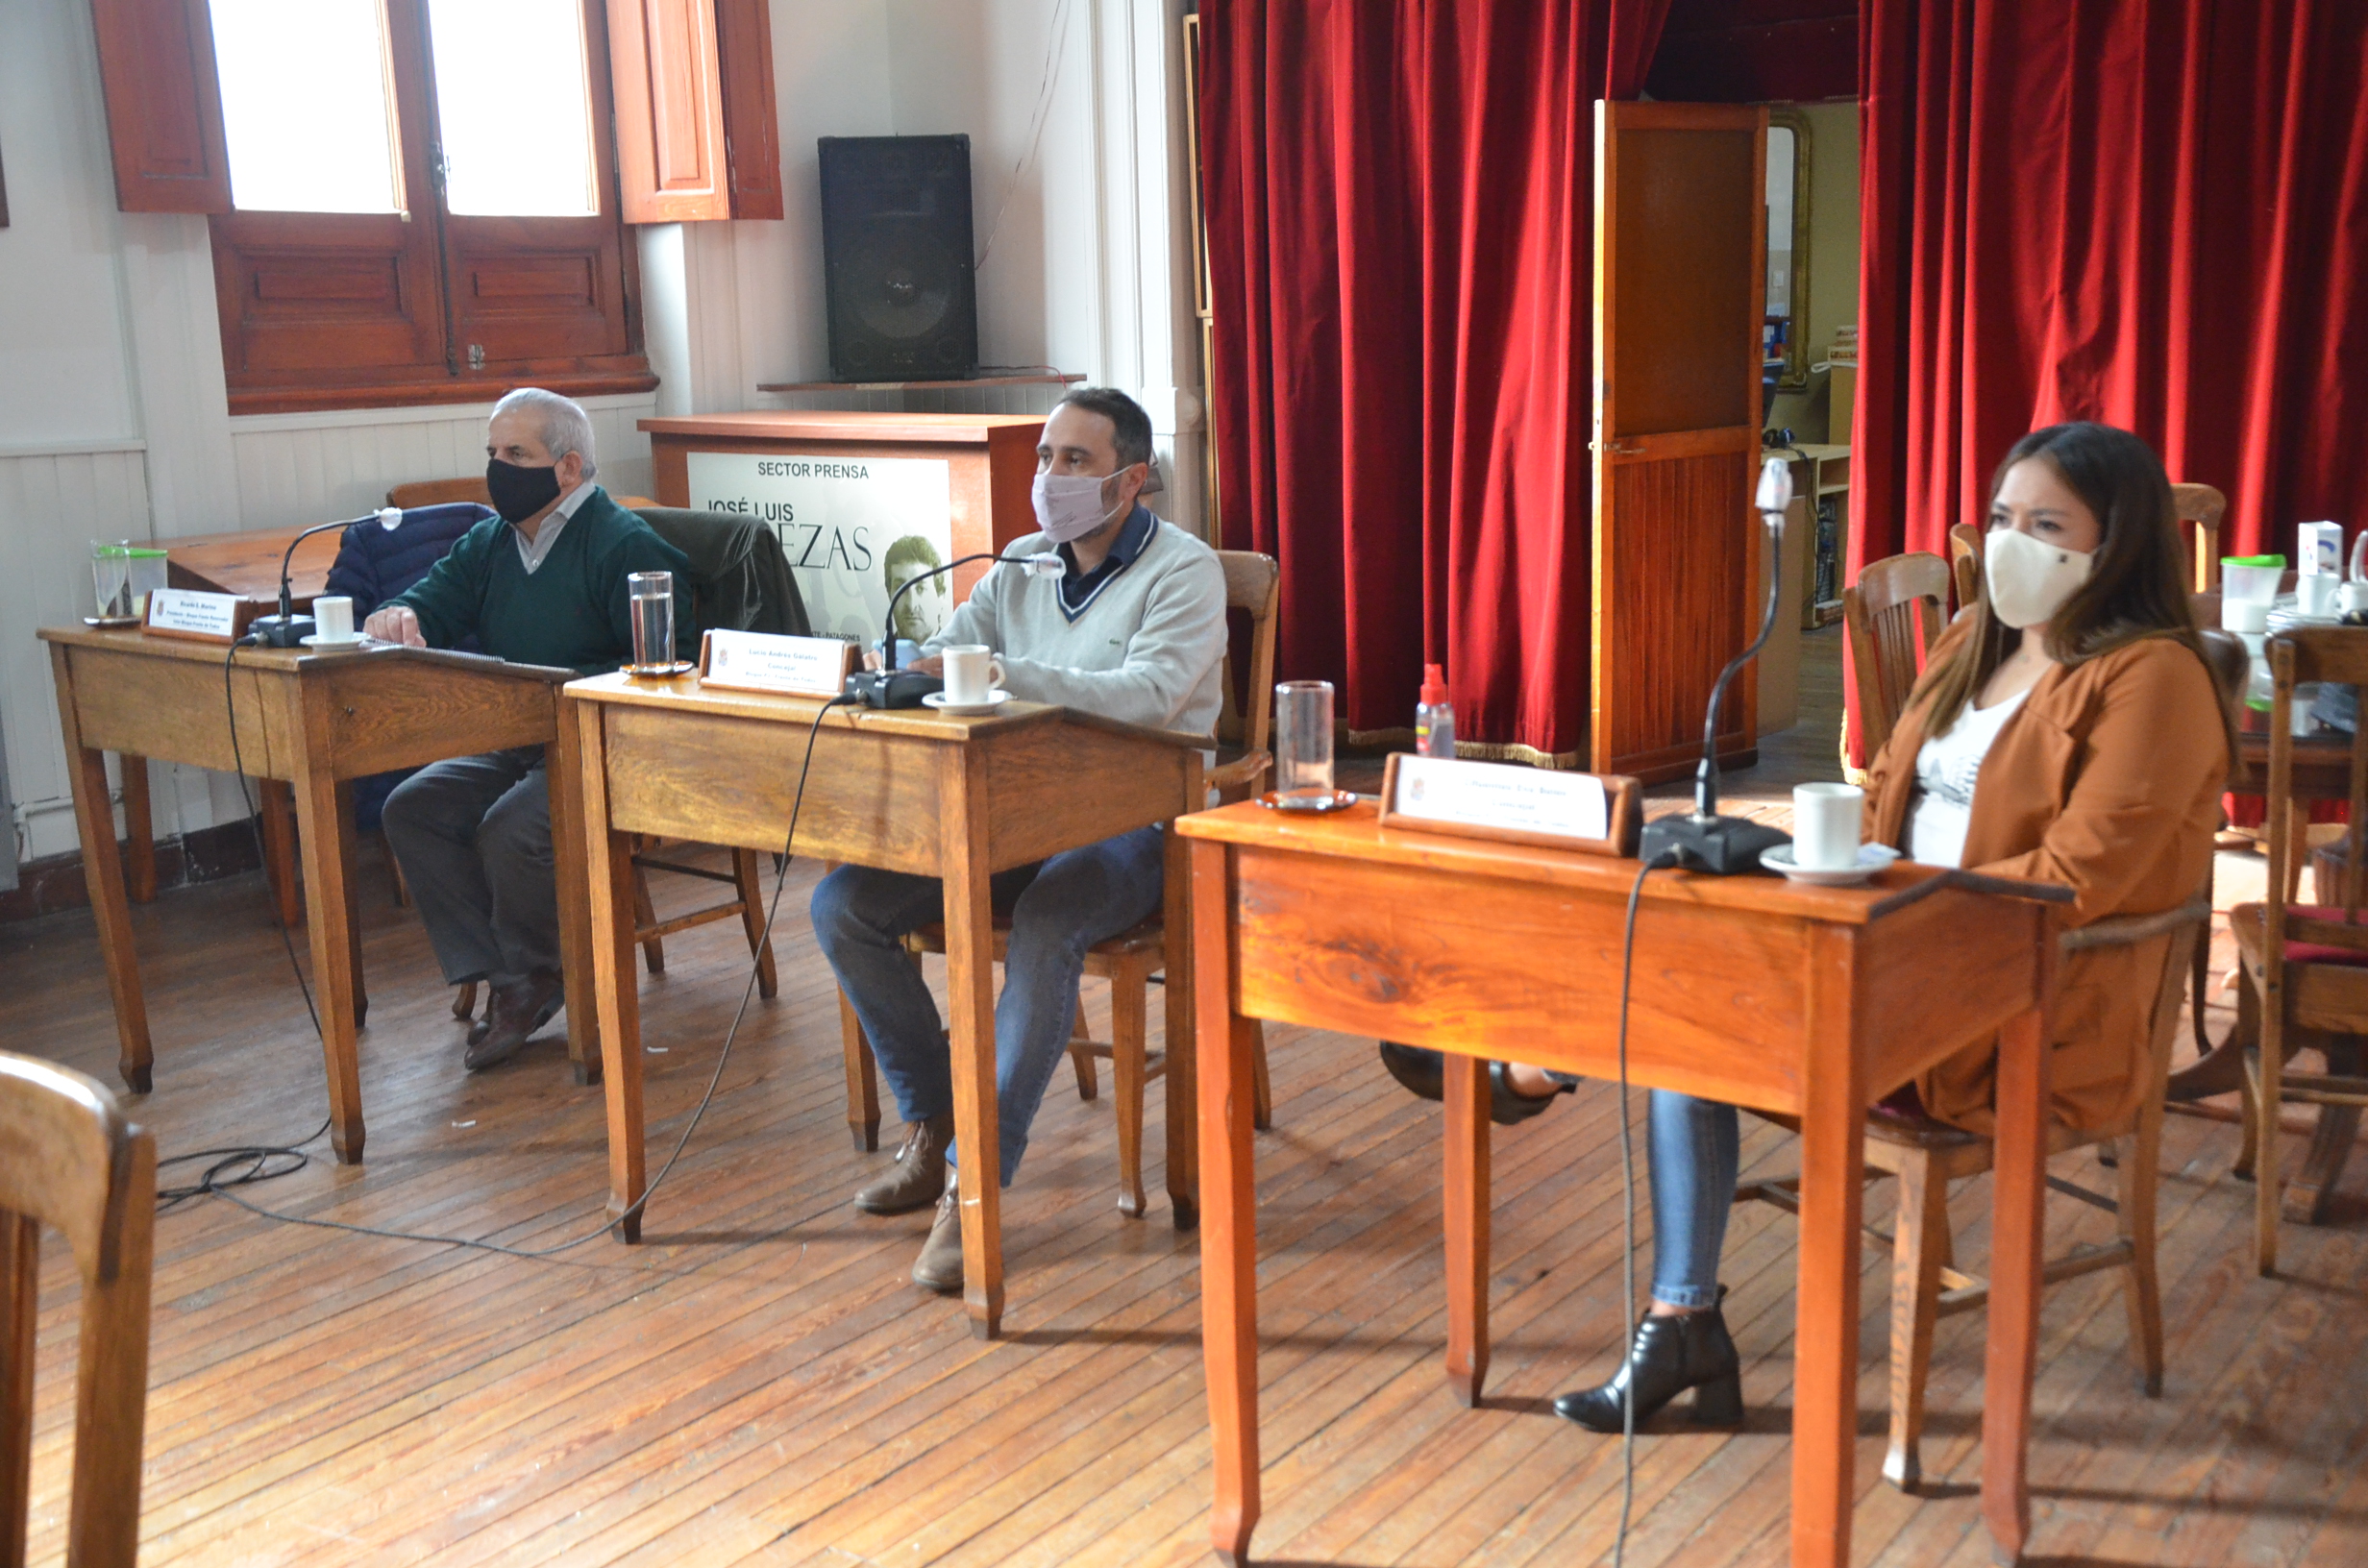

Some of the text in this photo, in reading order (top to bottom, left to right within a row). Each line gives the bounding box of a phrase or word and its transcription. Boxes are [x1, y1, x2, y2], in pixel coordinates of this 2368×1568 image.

[757, 461, 870, 479] SECTOR PRENSA
[707, 496, 795, 523] JOSÉ LUIS
[777, 522, 873, 572] EZAS
[749, 648, 767, 656] Lucio
[767, 662, 797, 672] Concejal
